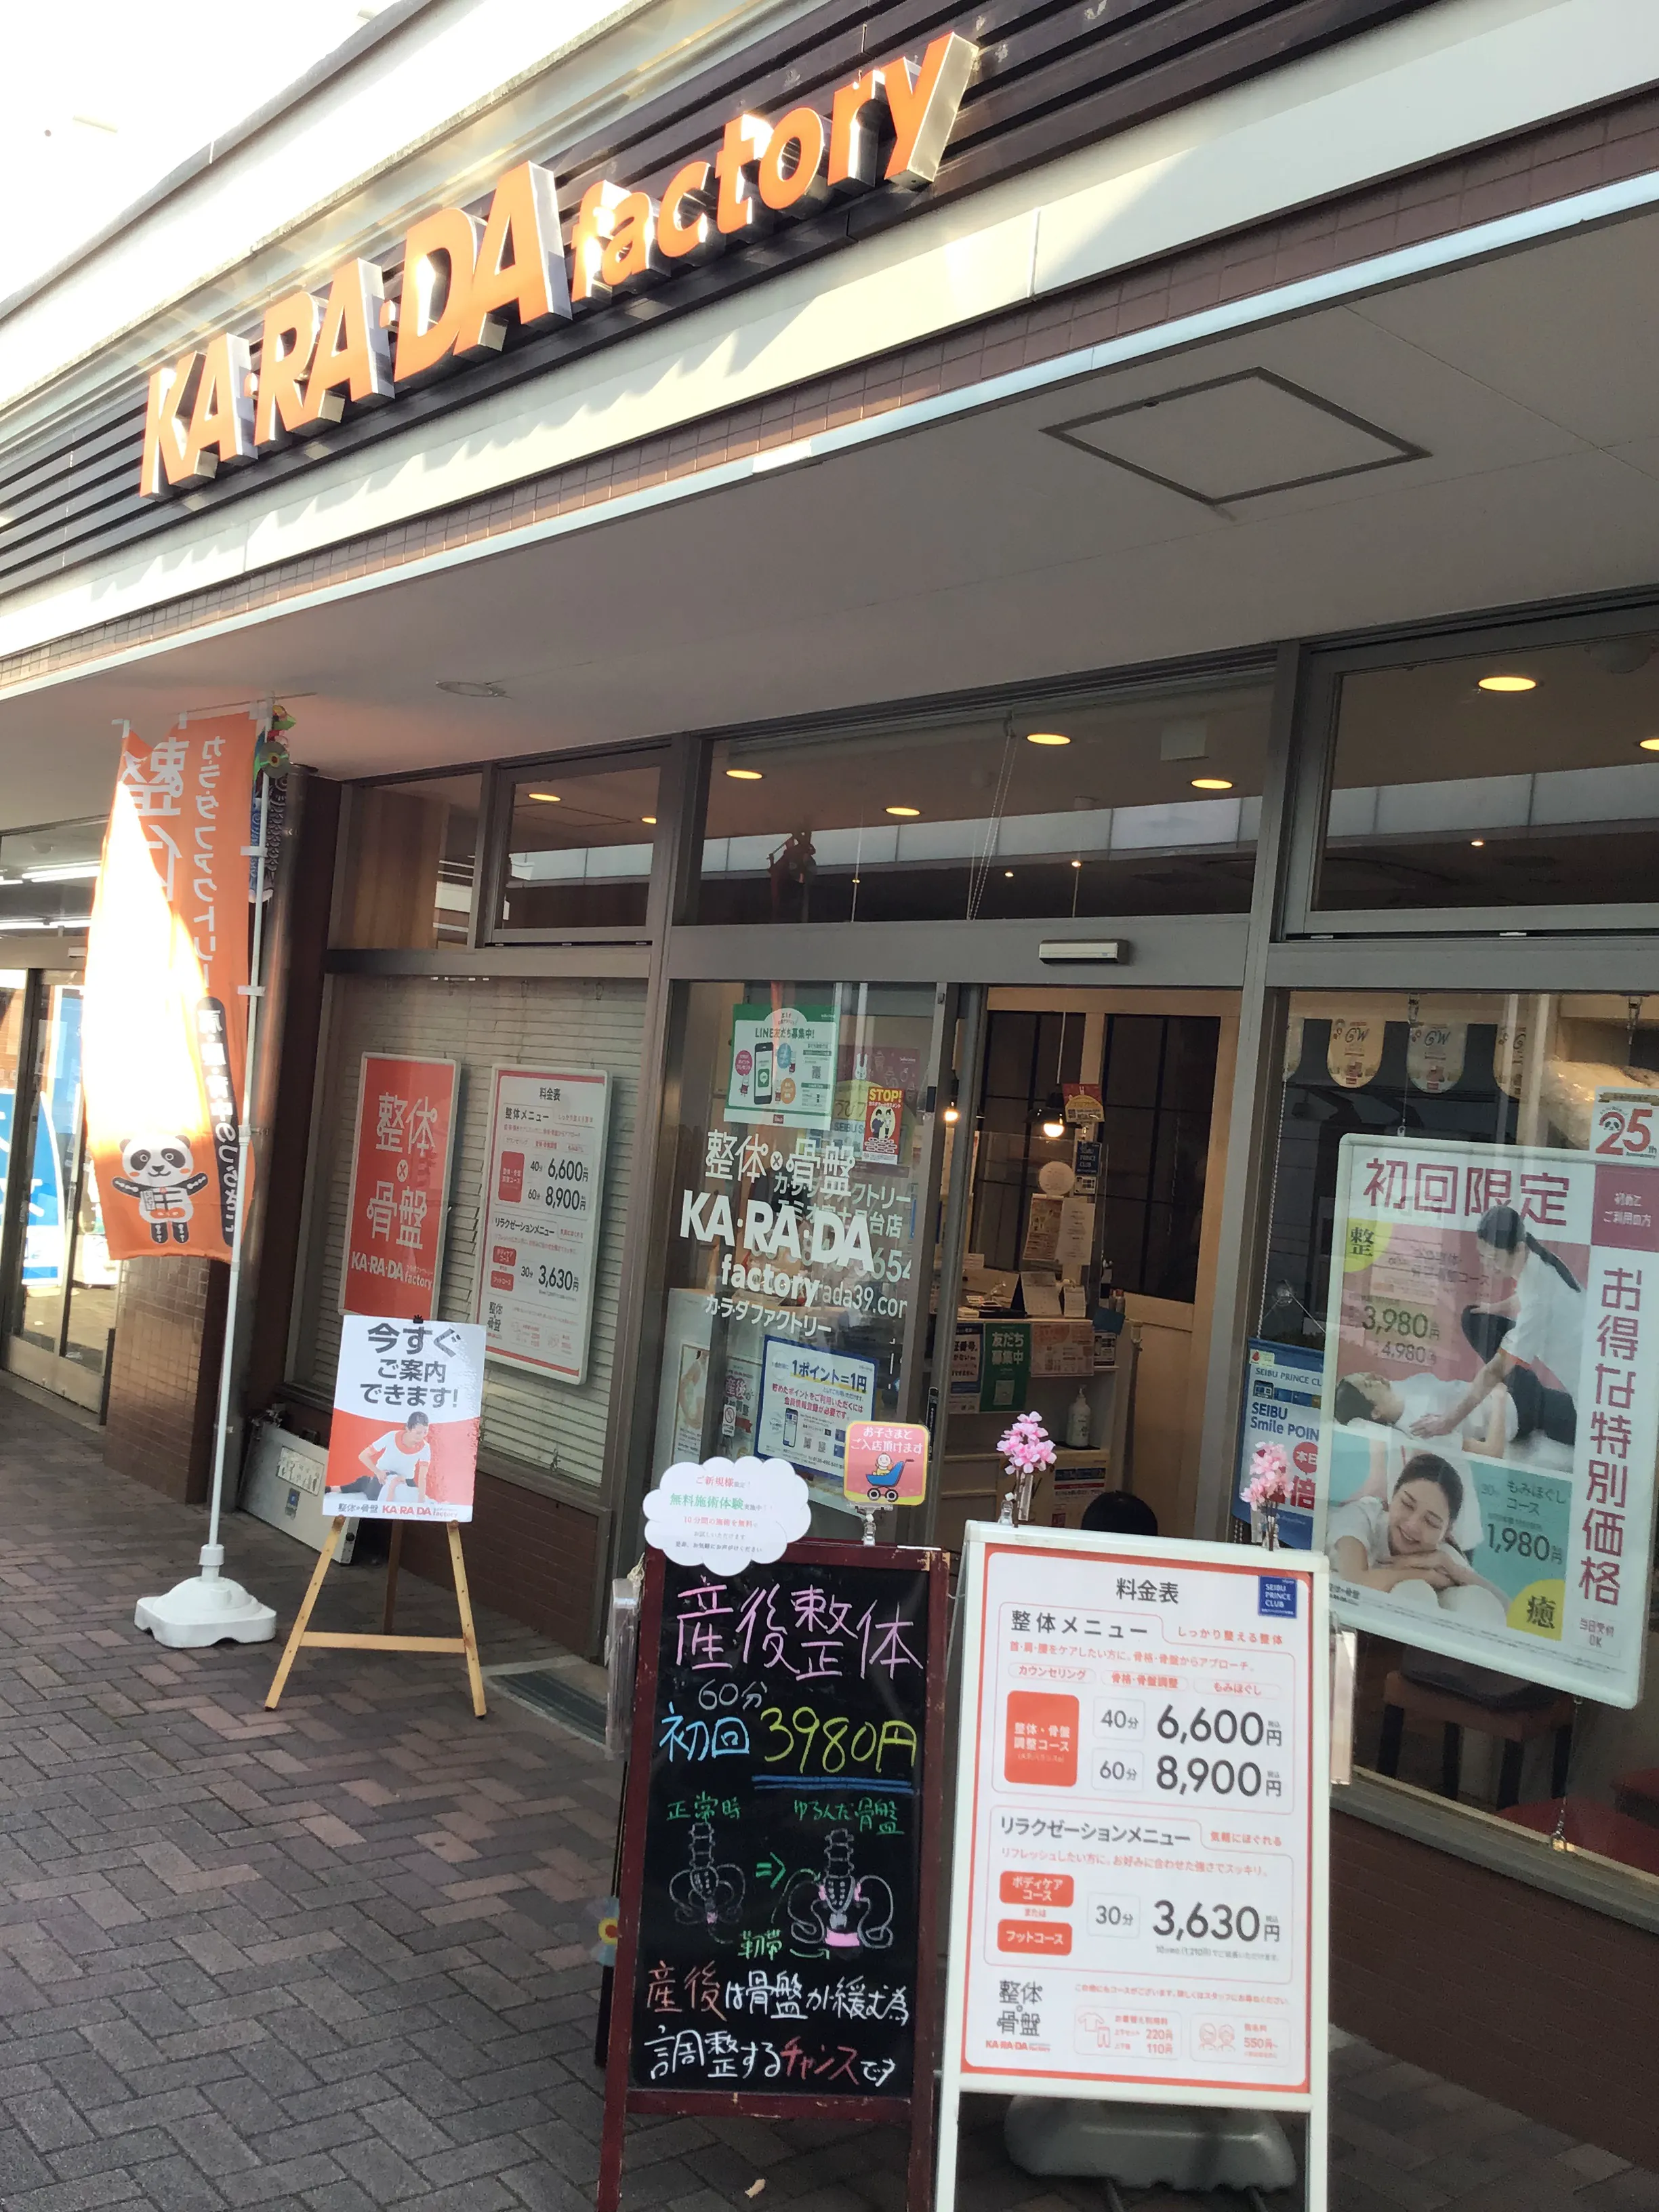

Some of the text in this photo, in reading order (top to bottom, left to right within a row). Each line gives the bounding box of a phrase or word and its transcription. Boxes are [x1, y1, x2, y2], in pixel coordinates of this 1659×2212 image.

[570, 31, 979, 306] factory
[539, 1087, 561, 1102] 料金表
[869, 1088, 902, 1103] STOP!
[375, 1091, 438, 1157] 整体
[505, 1107, 550, 1122] 整体メニュー
[1595, 1108, 1653, 1155] 25
[1363, 1158, 1570, 1227] 初回限定
[367, 1179, 428, 1250] 骨盤
[495, 1216, 555, 1237] リラクゼーションメニュー
[1350, 1226, 1375, 1257] 整
[405, 1270, 432, 1291] factory
[721, 1254, 821, 1308] factory
[367, 1322, 462, 1358] 今すぐ
[991, 1331, 1025, 1347] 友だち
[377, 1358, 447, 1383] ご案内
[1255, 1367, 1279, 1378] SEIBU
[1280, 1372, 1309, 1385] PRINCE
[359, 1383, 459, 1408] できます!
[1252, 1401, 1288, 1420] SEIBU
[863, 1427, 914, 1440] お子さまと
[1250, 1416, 1284, 1435] Smile
[1578, 1267, 1642, 1605] お得な特別価格
[851, 1437, 923, 1456] ご入店頂けます
[1507, 1496, 1540, 1517] コース
[1115, 1576, 1180, 1605] 料金表
[1265, 1583, 1287, 1592] SEIBU
[1265, 1591, 1292, 1601] PRINCE
[1265, 1599, 1285, 1608] CLUB
[1526, 1595, 1556, 1630] 癒
[676, 1574, 924, 1681] 産後整体
[1010, 1610, 1148, 1639] 整体メニュー
[1178, 1626, 1284, 1645] しっかり整える整体
[1589, 1633, 1602, 1648] OK
[1018, 1664, 1087, 1681] カウンセリング
[698, 1678, 768, 1711] 60分
[1212, 1681, 1263, 1697] もみほぐし
[1100, 1708, 1139, 1730] 40分
[659, 1700, 918, 1774] 初回 3980円
[1013, 1736, 1069, 1753] 調整コース
[1099, 1760, 1138, 1782] 60分
[665, 1790, 742, 1824] 正常時
[793, 1797, 905, 1836] ゆるんだ骨盤
[1000, 1816, 1191, 1847] リラクゼーションメニュー
[1209, 1830, 1282, 1848] 気軽にほぐれる
[1012, 1877, 1063, 1890] ボディケア
[1022, 1889, 1053, 1903] コース
[1094, 1904, 1134, 1927] 30分
[1005, 1929, 1064, 1946] フットコース
[998, 1979, 1043, 2005] 整体
[996, 2009, 1040, 2037] 骨盤
[643, 2024, 897, 2087] 調整するチャンスです
